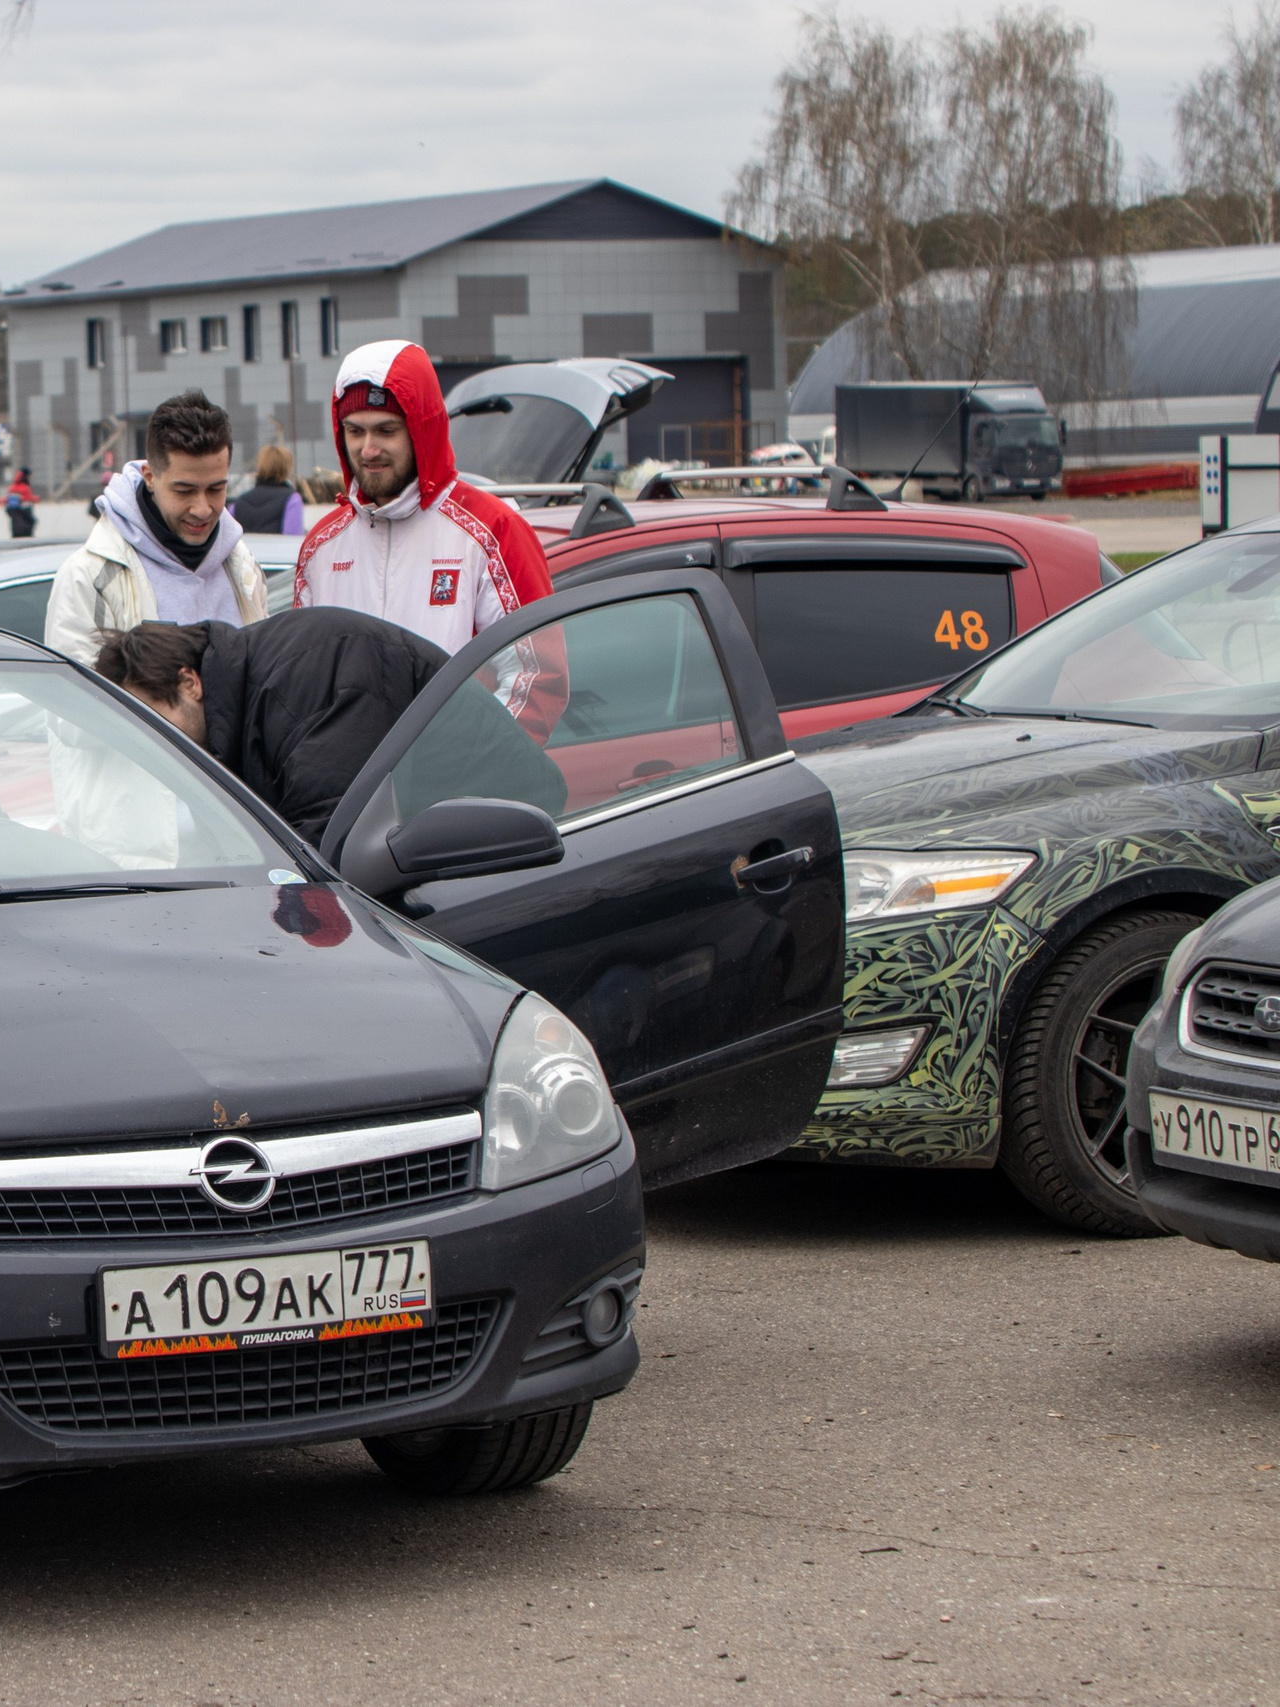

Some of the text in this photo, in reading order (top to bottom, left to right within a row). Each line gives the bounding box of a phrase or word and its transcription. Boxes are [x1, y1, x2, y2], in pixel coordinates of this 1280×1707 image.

[934, 610, 989, 651] 48
[1160, 1104, 1259, 1163] У910ТР
[124, 1246, 414, 1335] А109АК 777
[363, 1293, 399, 1312] RUS
[241, 1329, 314, 1346] ПУШКАГОНКА
